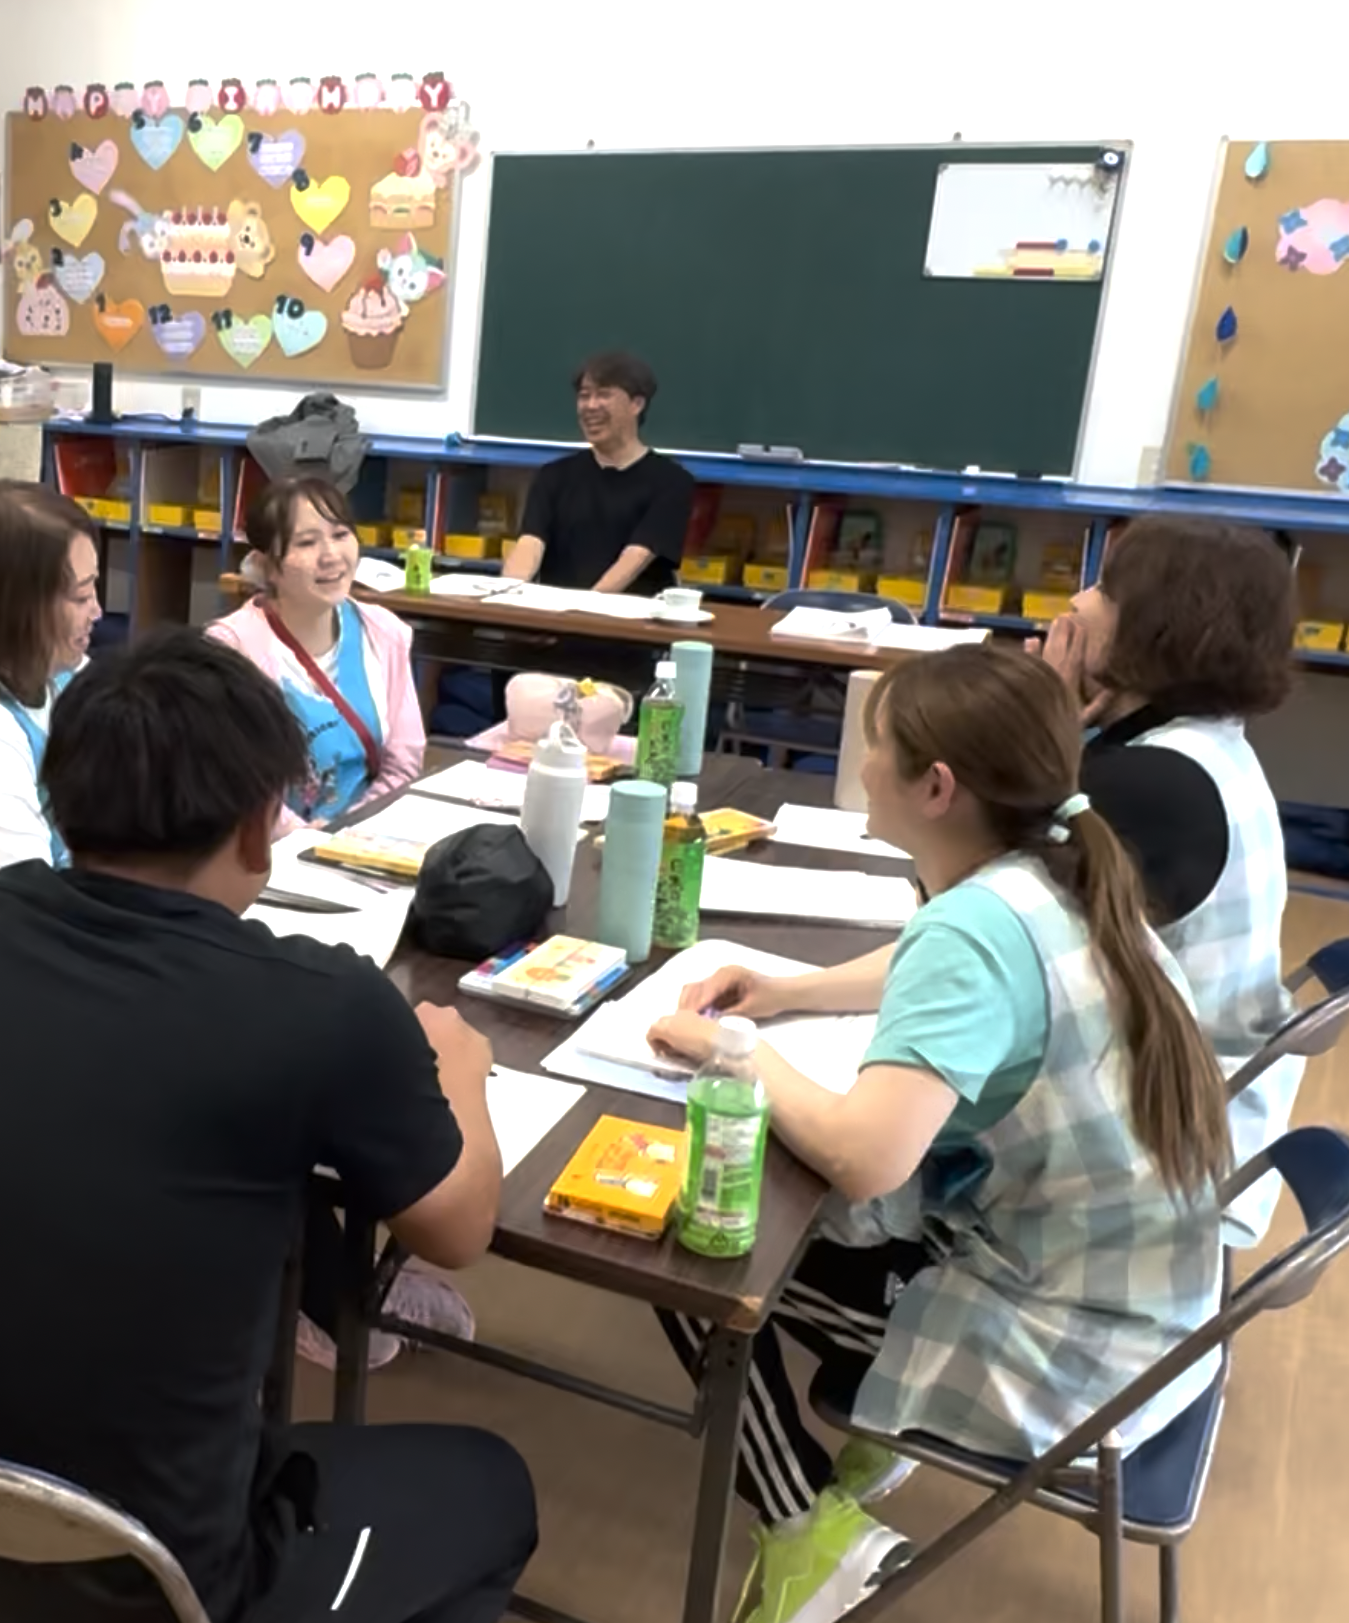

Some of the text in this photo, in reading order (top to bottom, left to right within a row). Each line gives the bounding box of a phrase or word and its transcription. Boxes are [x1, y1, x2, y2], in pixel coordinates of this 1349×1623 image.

[132, 109, 146, 130] 5
[188, 112, 202, 133] 6
[247, 132, 263, 155] 7
[300, 232, 315, 257] 9
[148, 303, 173, 325] 12
[275, 294, 304, 320] 10
[211, 307, 233, 331] 11
